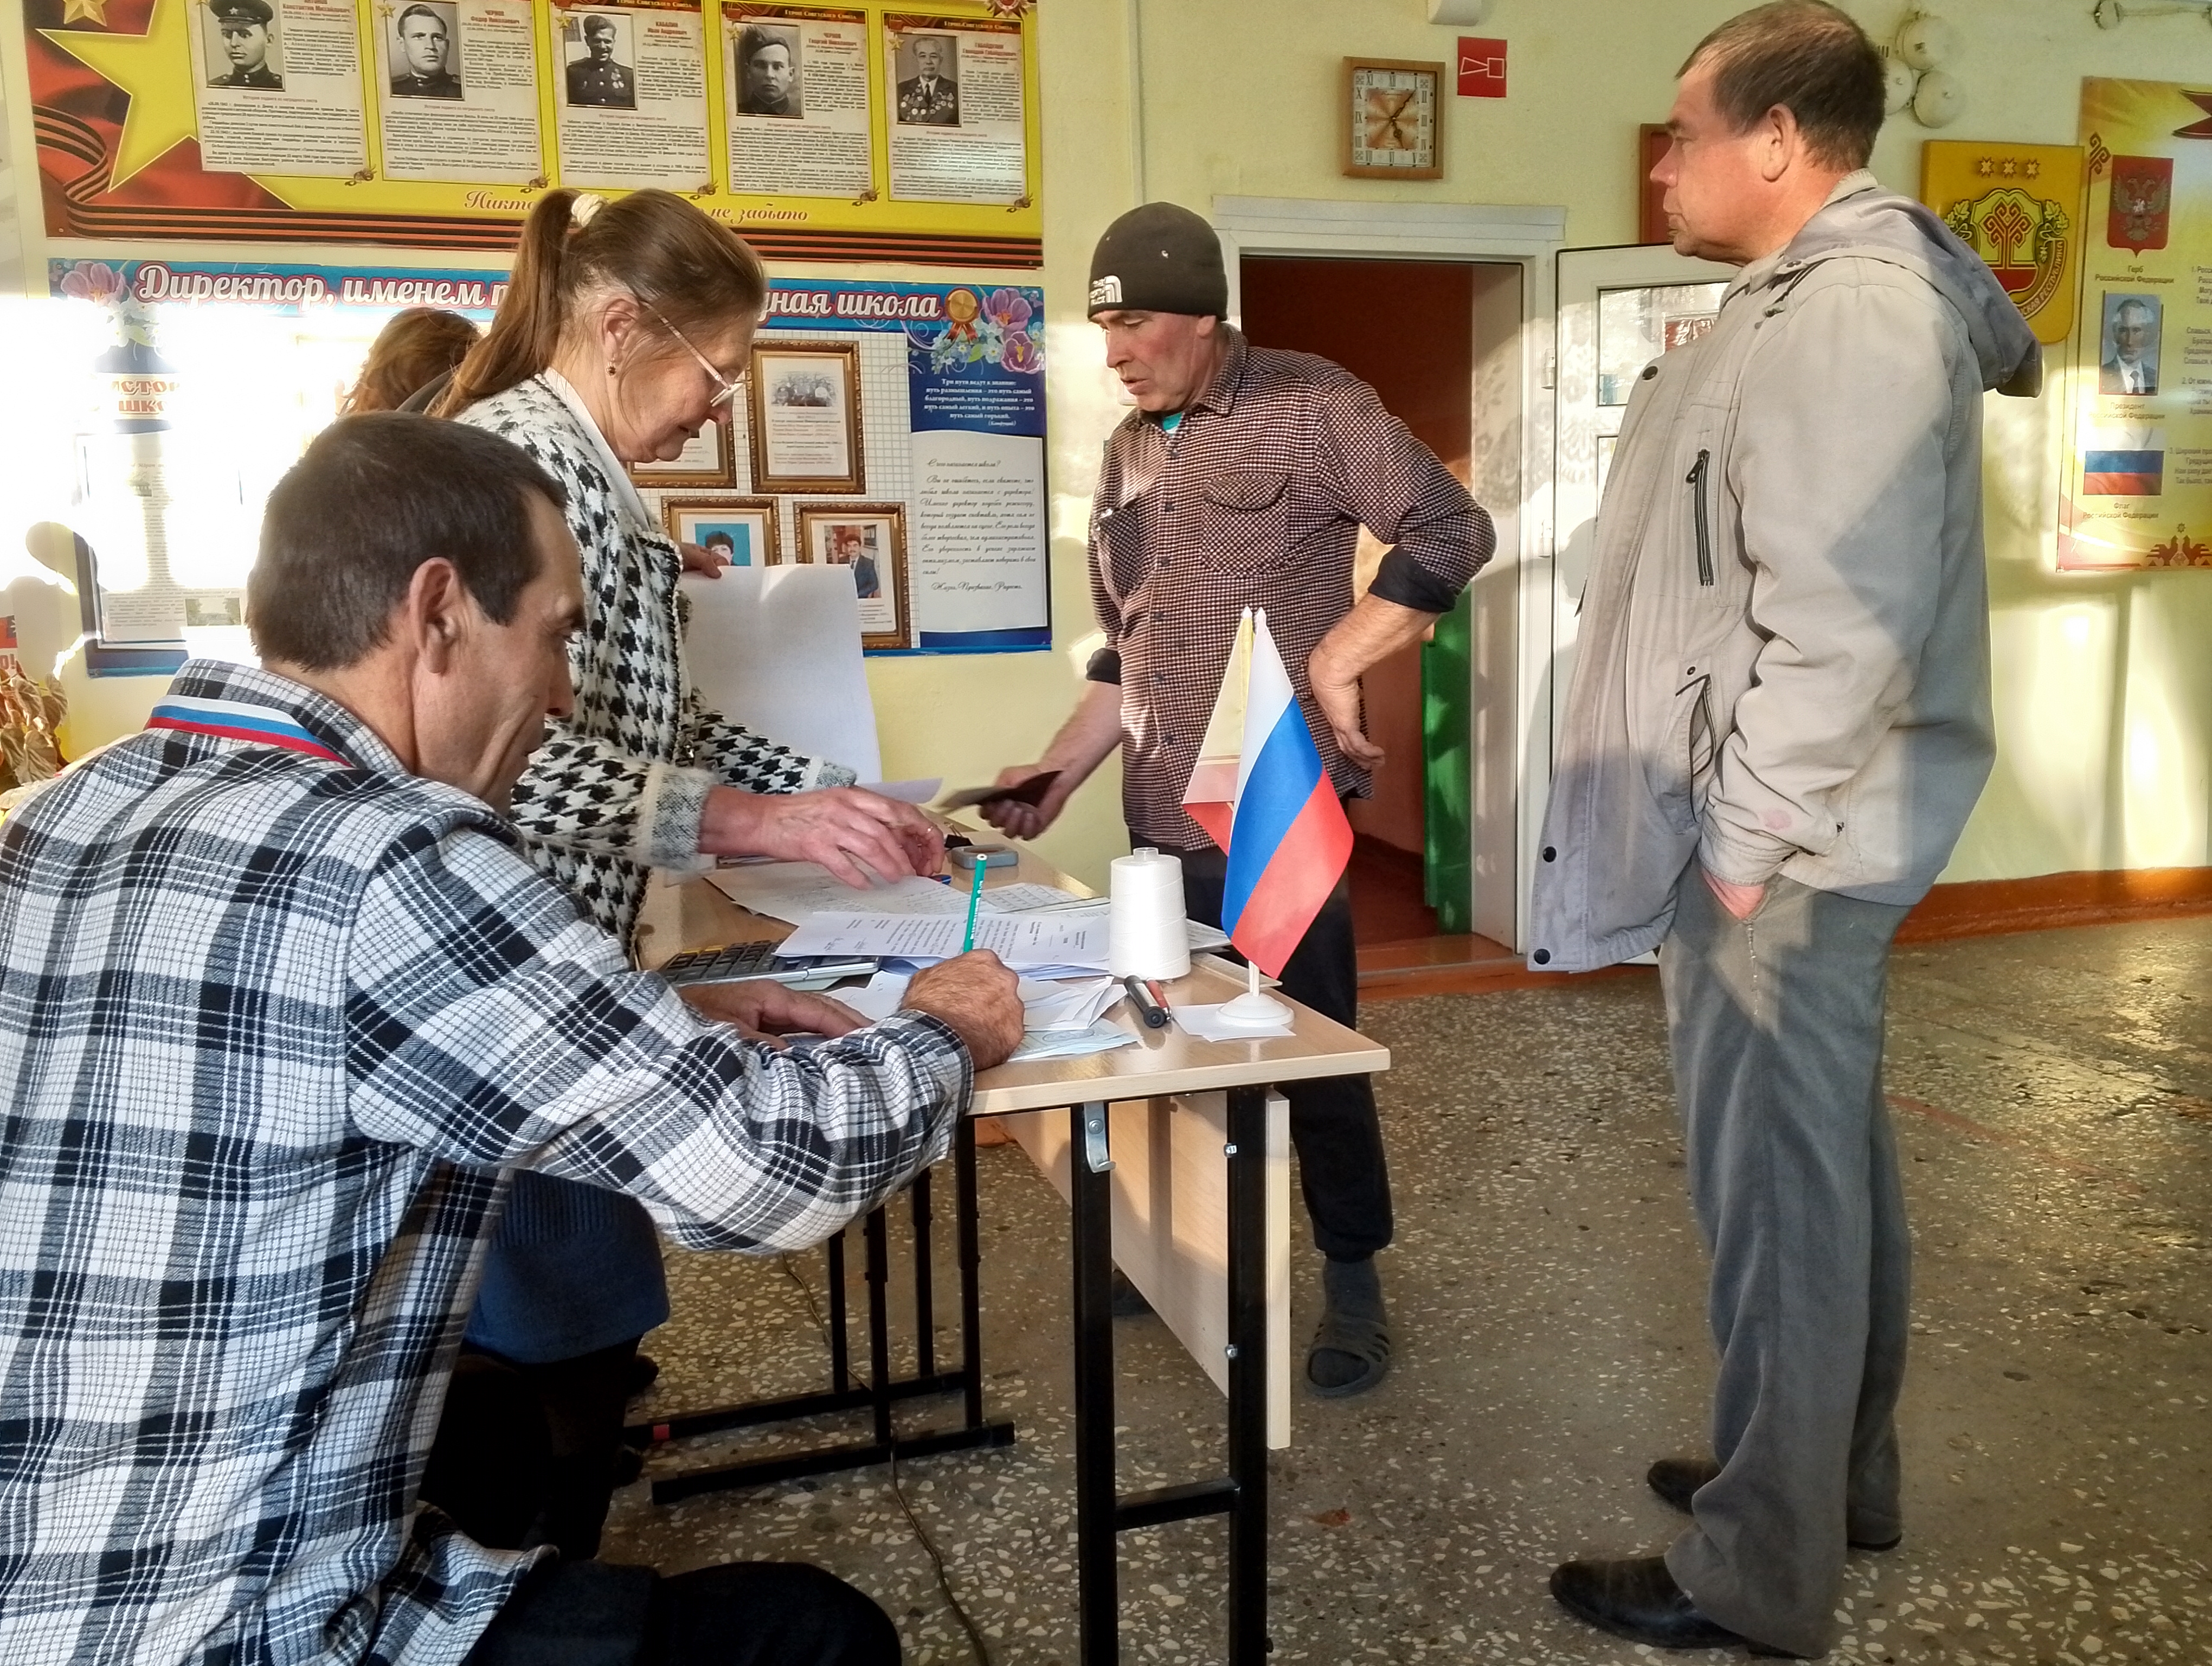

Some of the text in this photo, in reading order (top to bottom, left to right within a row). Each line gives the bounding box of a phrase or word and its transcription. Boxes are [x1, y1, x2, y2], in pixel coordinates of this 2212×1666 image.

[711, 203, 808, 225] не забыто
[2128, 265, 2144, 274] Герб
[138, 264, 335, 310] Директор,
[343, 276, 487, 307] именем
[2137, 276, 2174, 284] Федерации
[837, 293, 941, 318] школа
[927, 475, 941, 483] Вы
